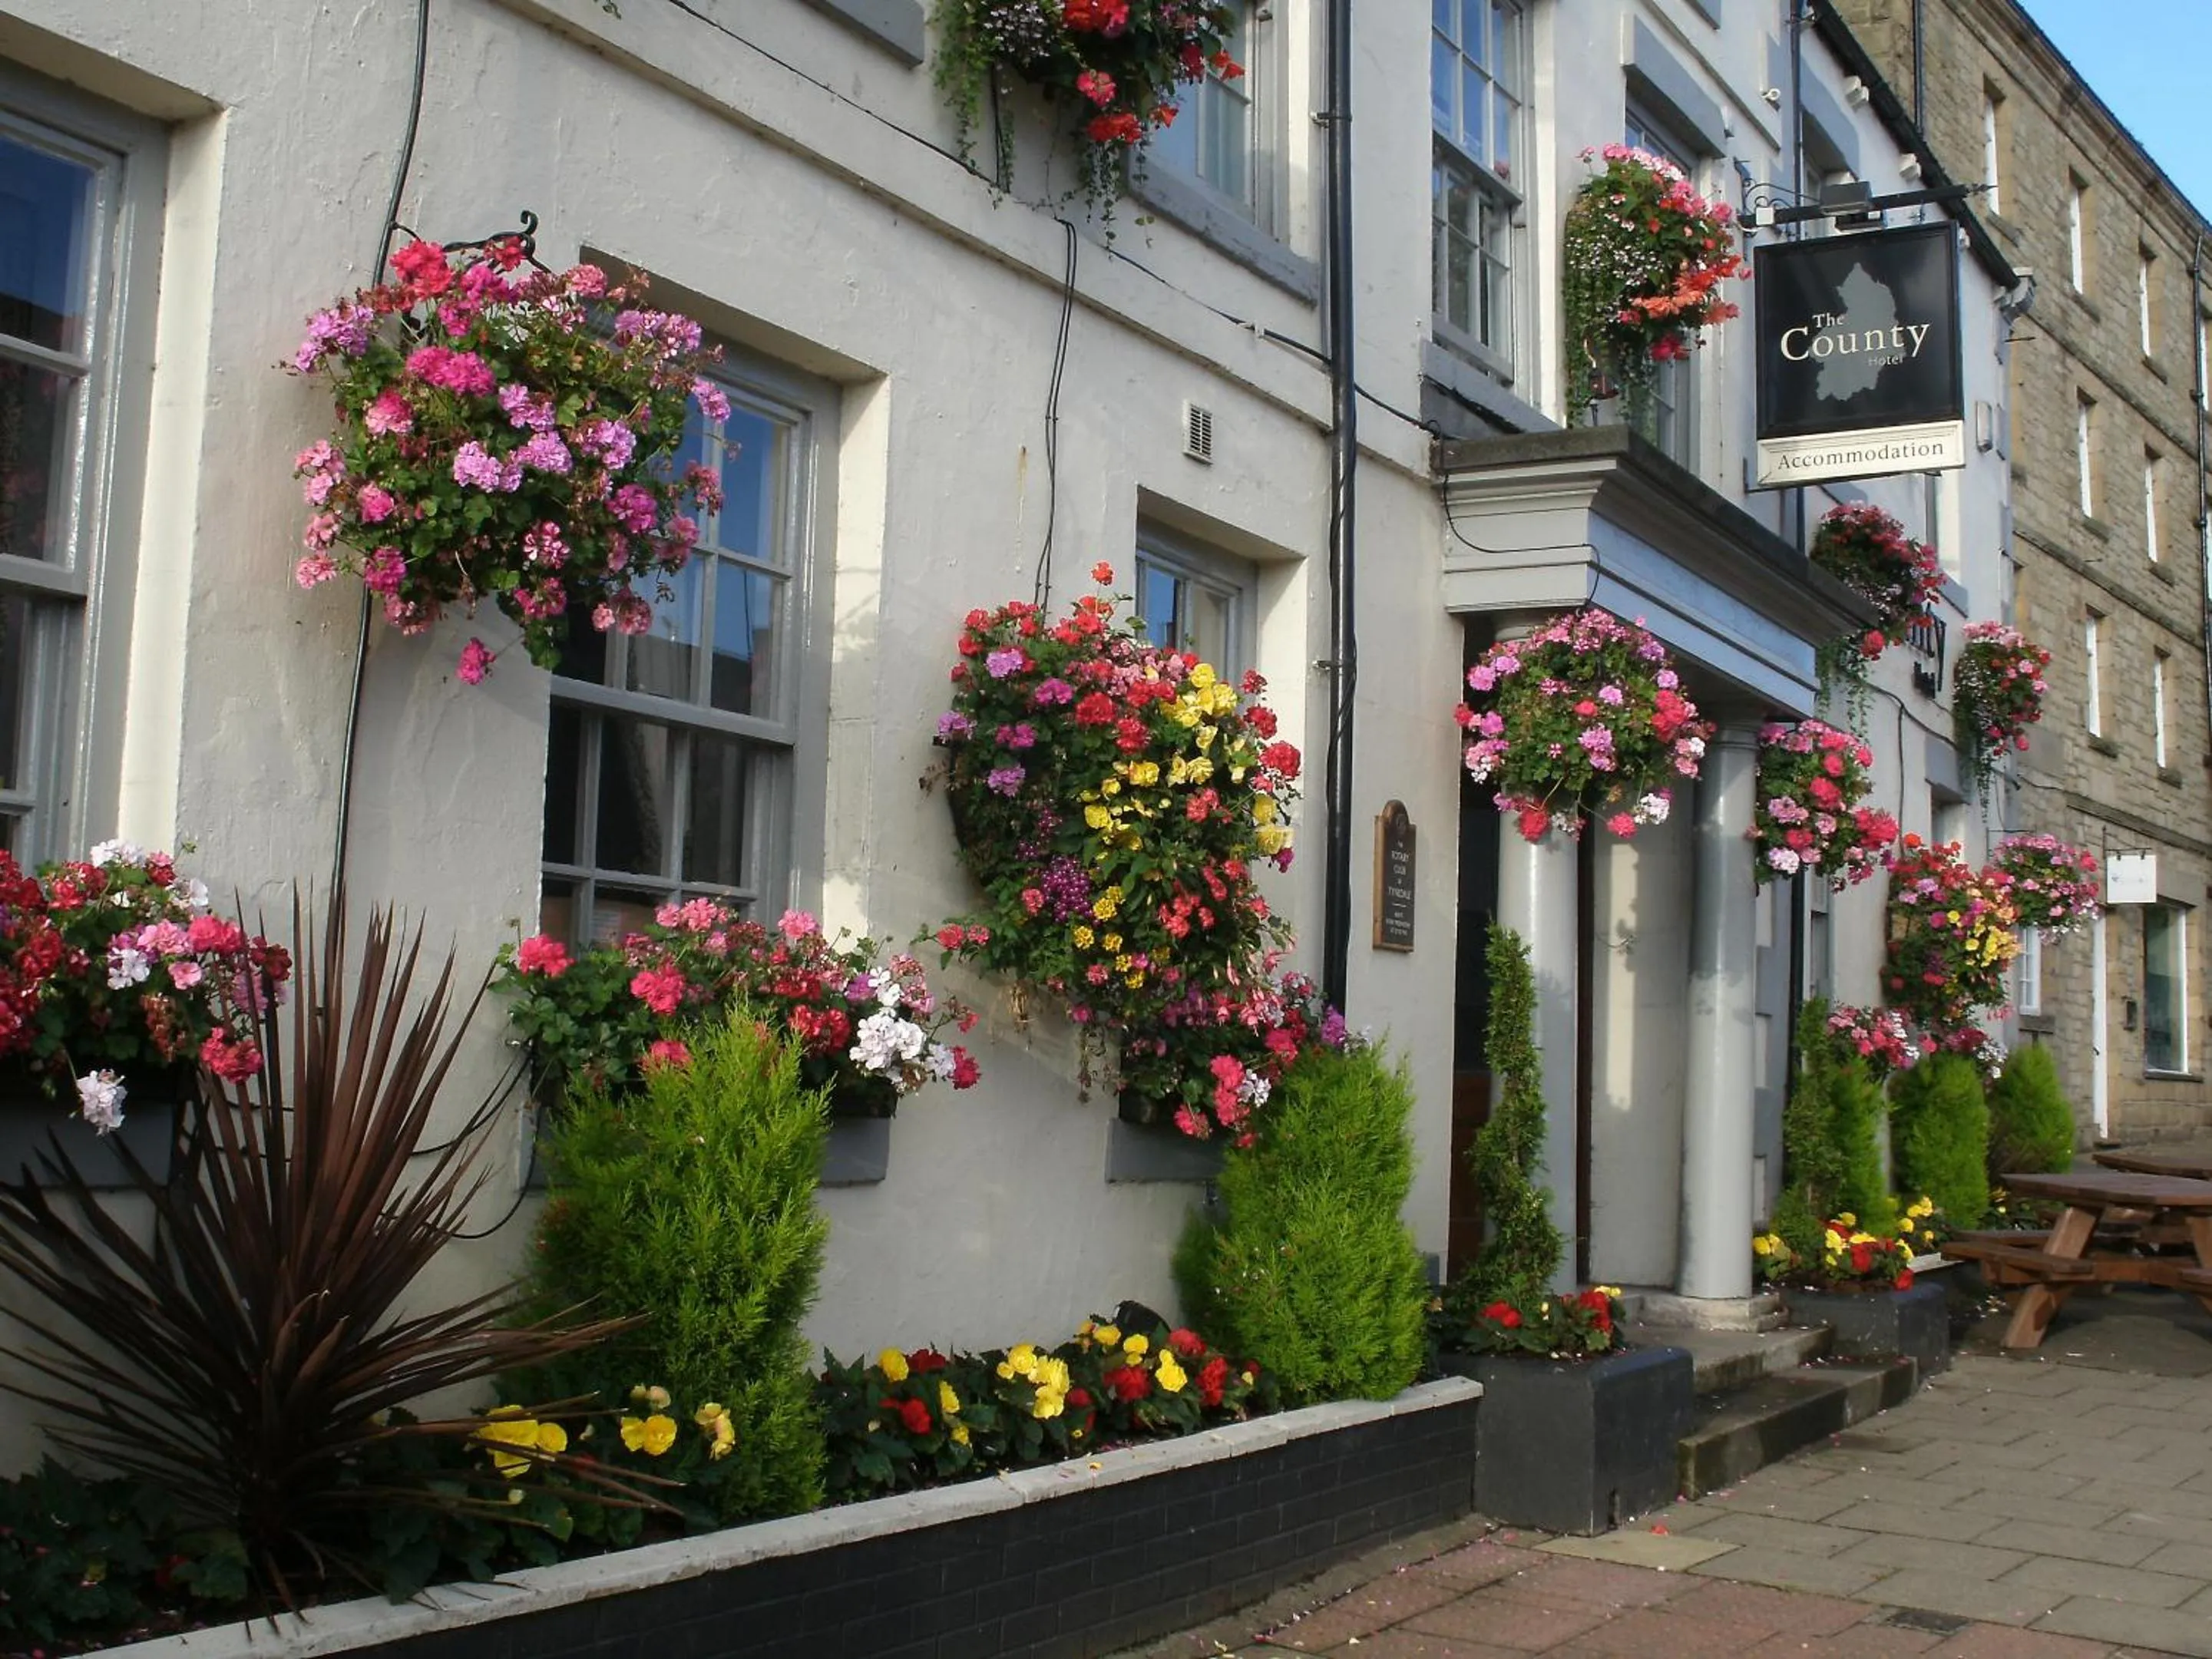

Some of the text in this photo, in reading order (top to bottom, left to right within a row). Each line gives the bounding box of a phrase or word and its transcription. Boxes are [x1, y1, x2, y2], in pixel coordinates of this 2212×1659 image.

[1812, 312, 1845, 329] The
[1780, 322, 1931, 362] County
[1867, 353, 1904, 367] Hotel
[1777, 442, 1944, 470] Accommodation
